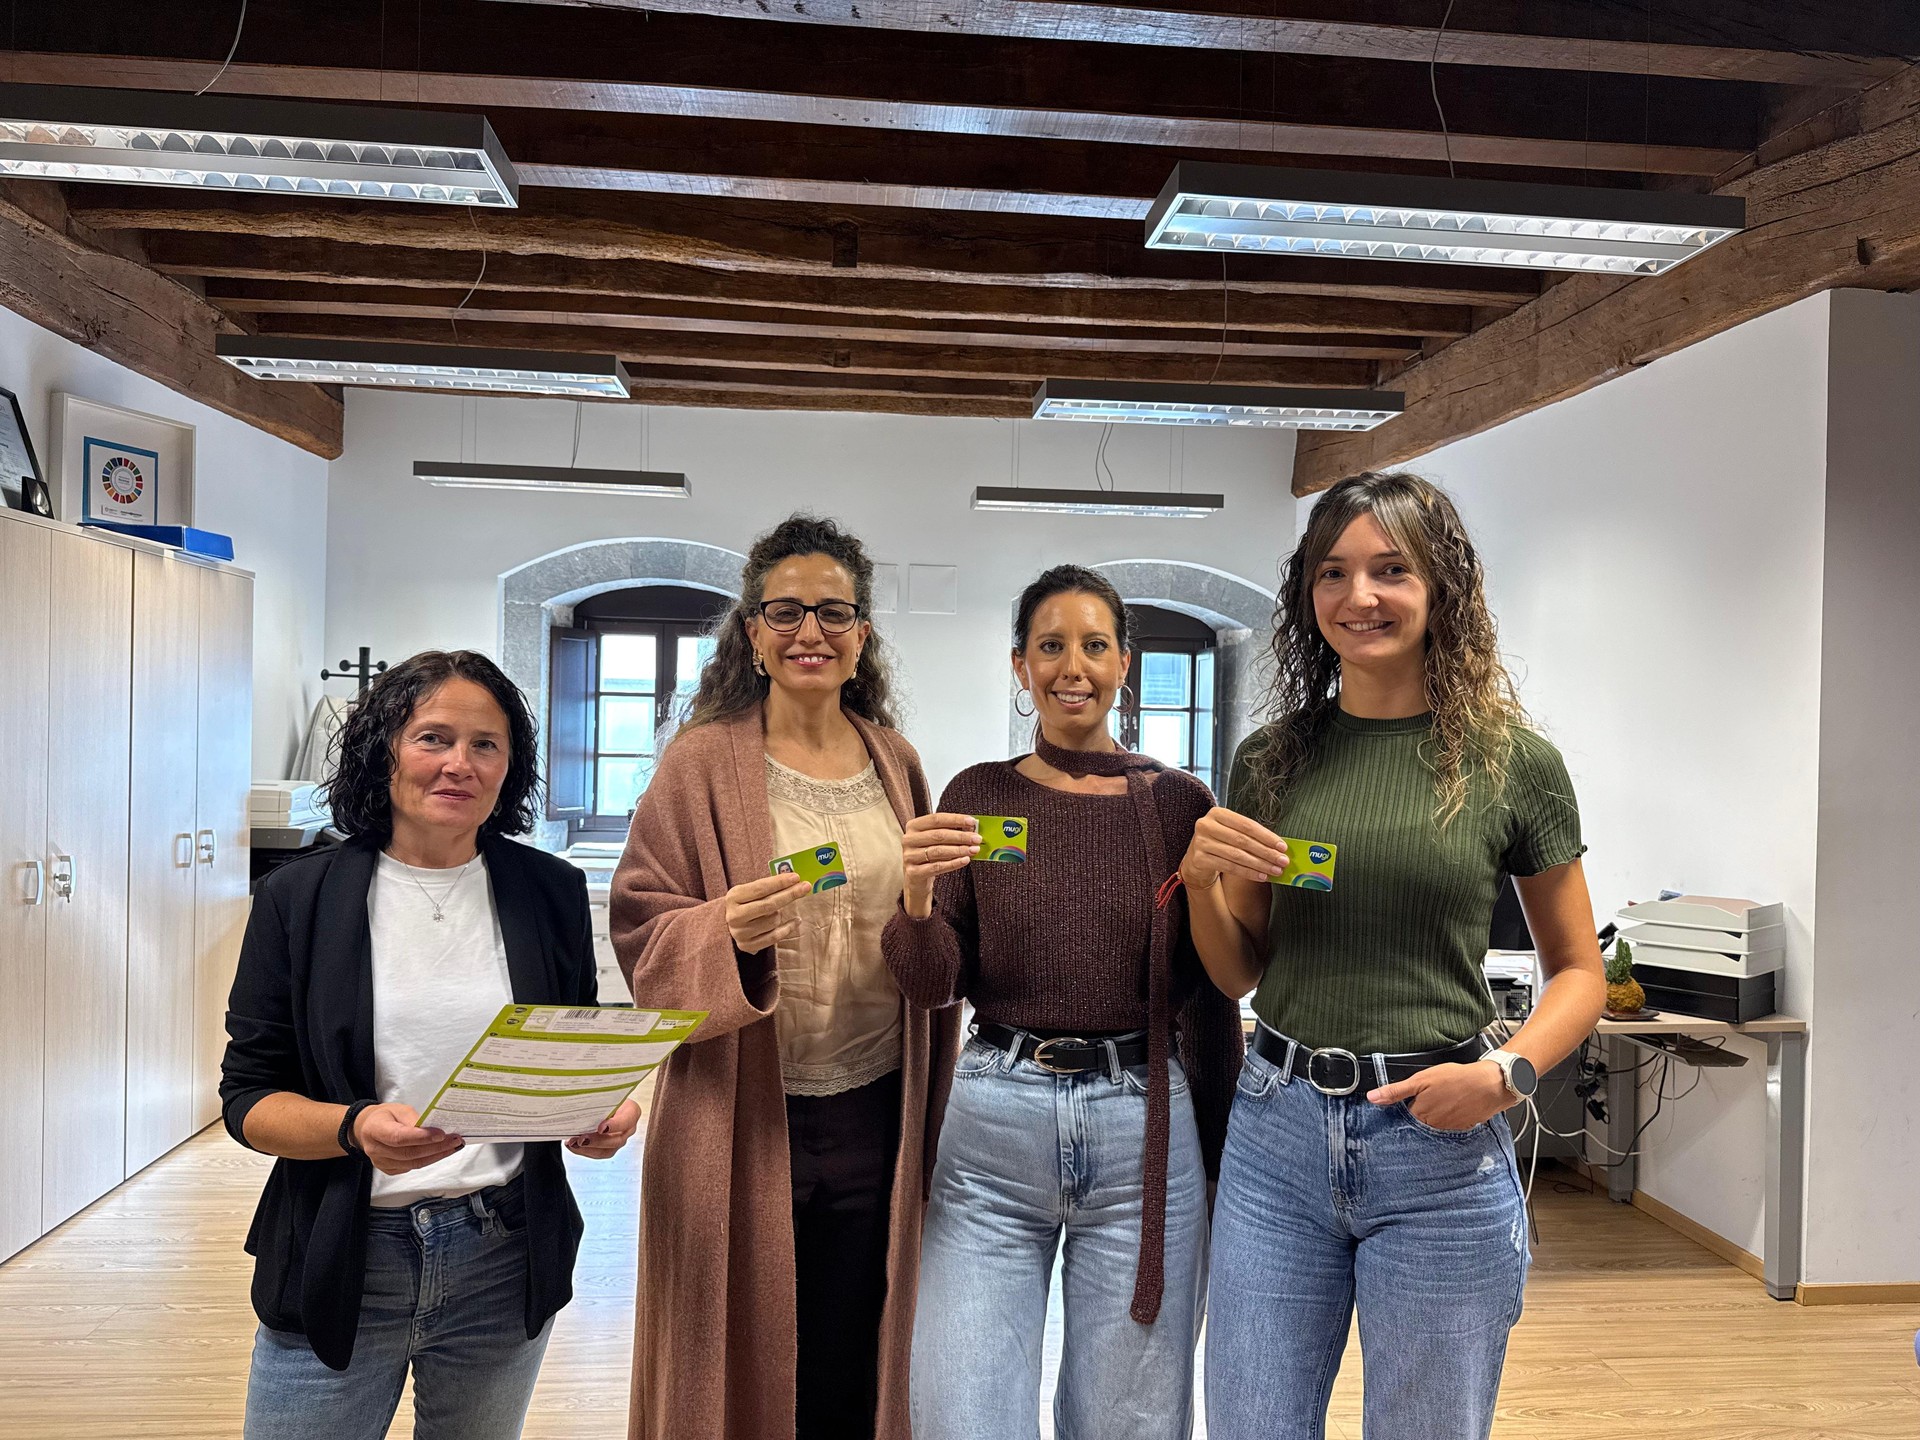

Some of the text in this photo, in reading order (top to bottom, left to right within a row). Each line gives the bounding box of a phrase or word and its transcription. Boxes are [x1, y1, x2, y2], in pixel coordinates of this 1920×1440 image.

[1003, 826, 1021, 834] mugi
[817, 851, 835, 861] mugi
[1309, 851, 1329, 860] mugi
